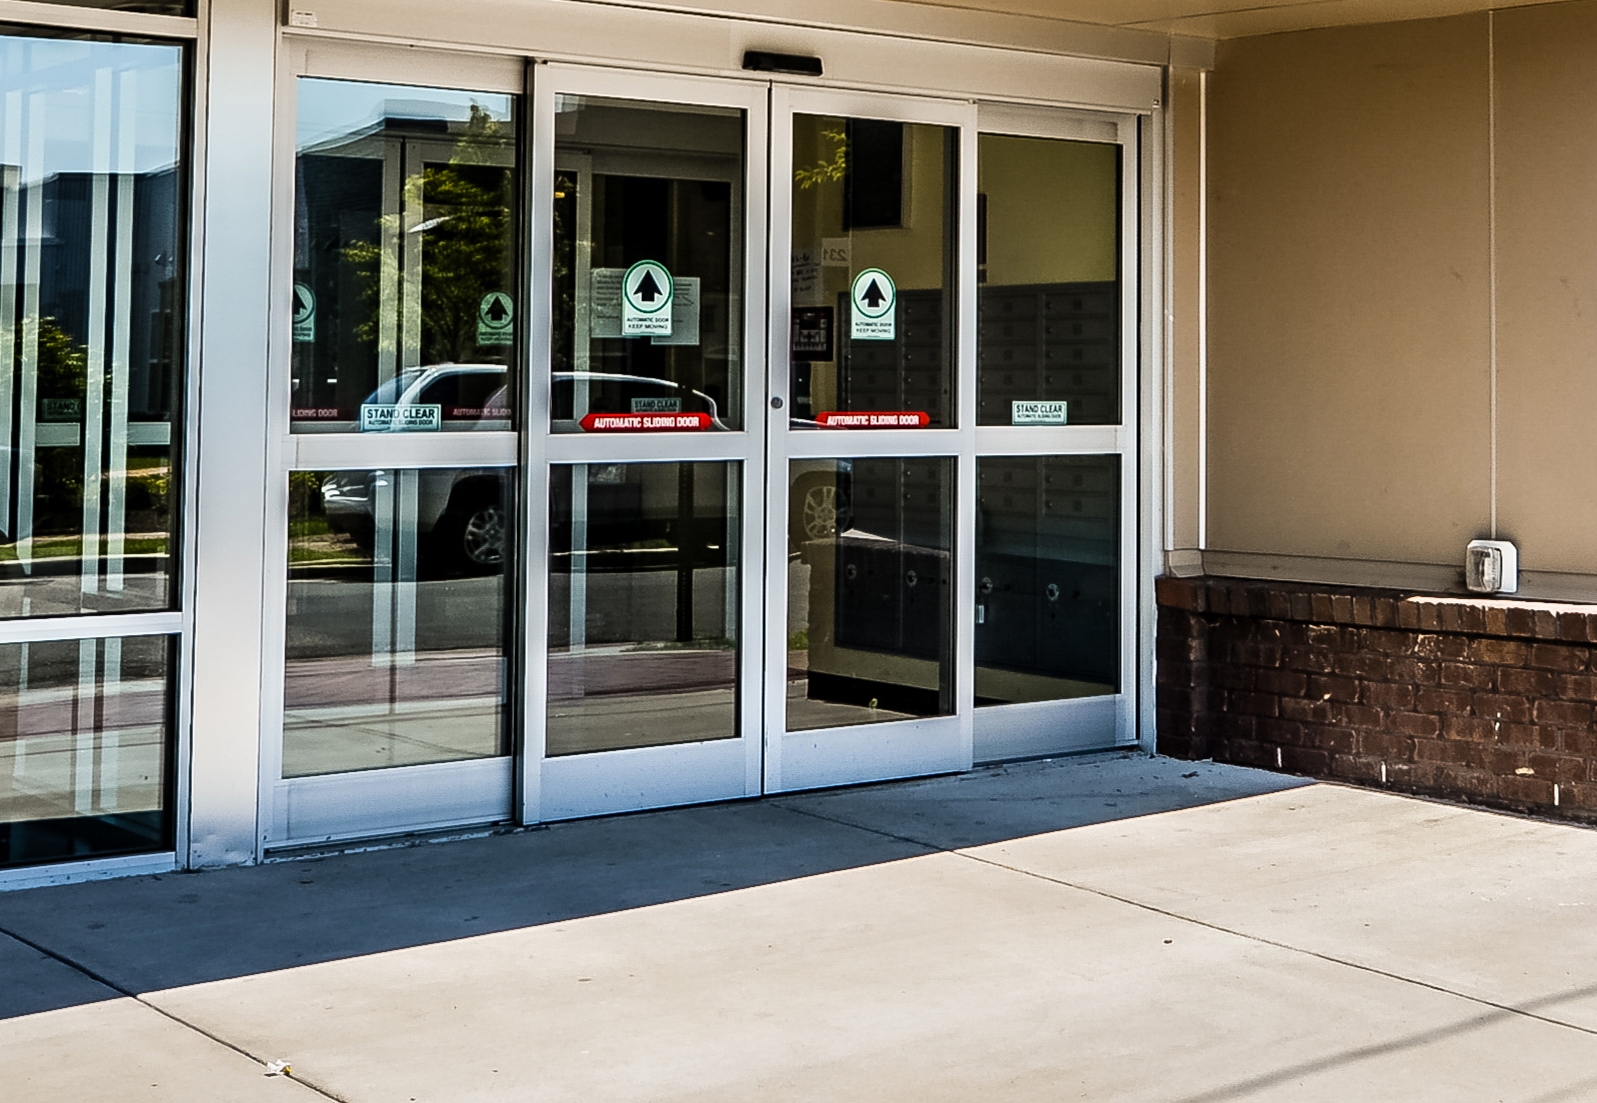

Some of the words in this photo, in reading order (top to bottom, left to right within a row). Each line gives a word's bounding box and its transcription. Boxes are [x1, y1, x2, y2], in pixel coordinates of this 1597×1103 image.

[367, 408, 400, 418] STAND
[402, 408, 435, 418] CLEAR
[1016, 404, 1038, 413] STAND
[1040, 404, 1063, 413] CLEAR
[594, 417, 642, 428] AUTOMATIC
[643, 417, 676, 427] SLIDING
[676, 416, 699, 427] DOOR
[827, 415, 869, 426] AUTOMATIC
[870, 415, 898, 425] SLIDING
[899, 415, 919, 425] DOOR
